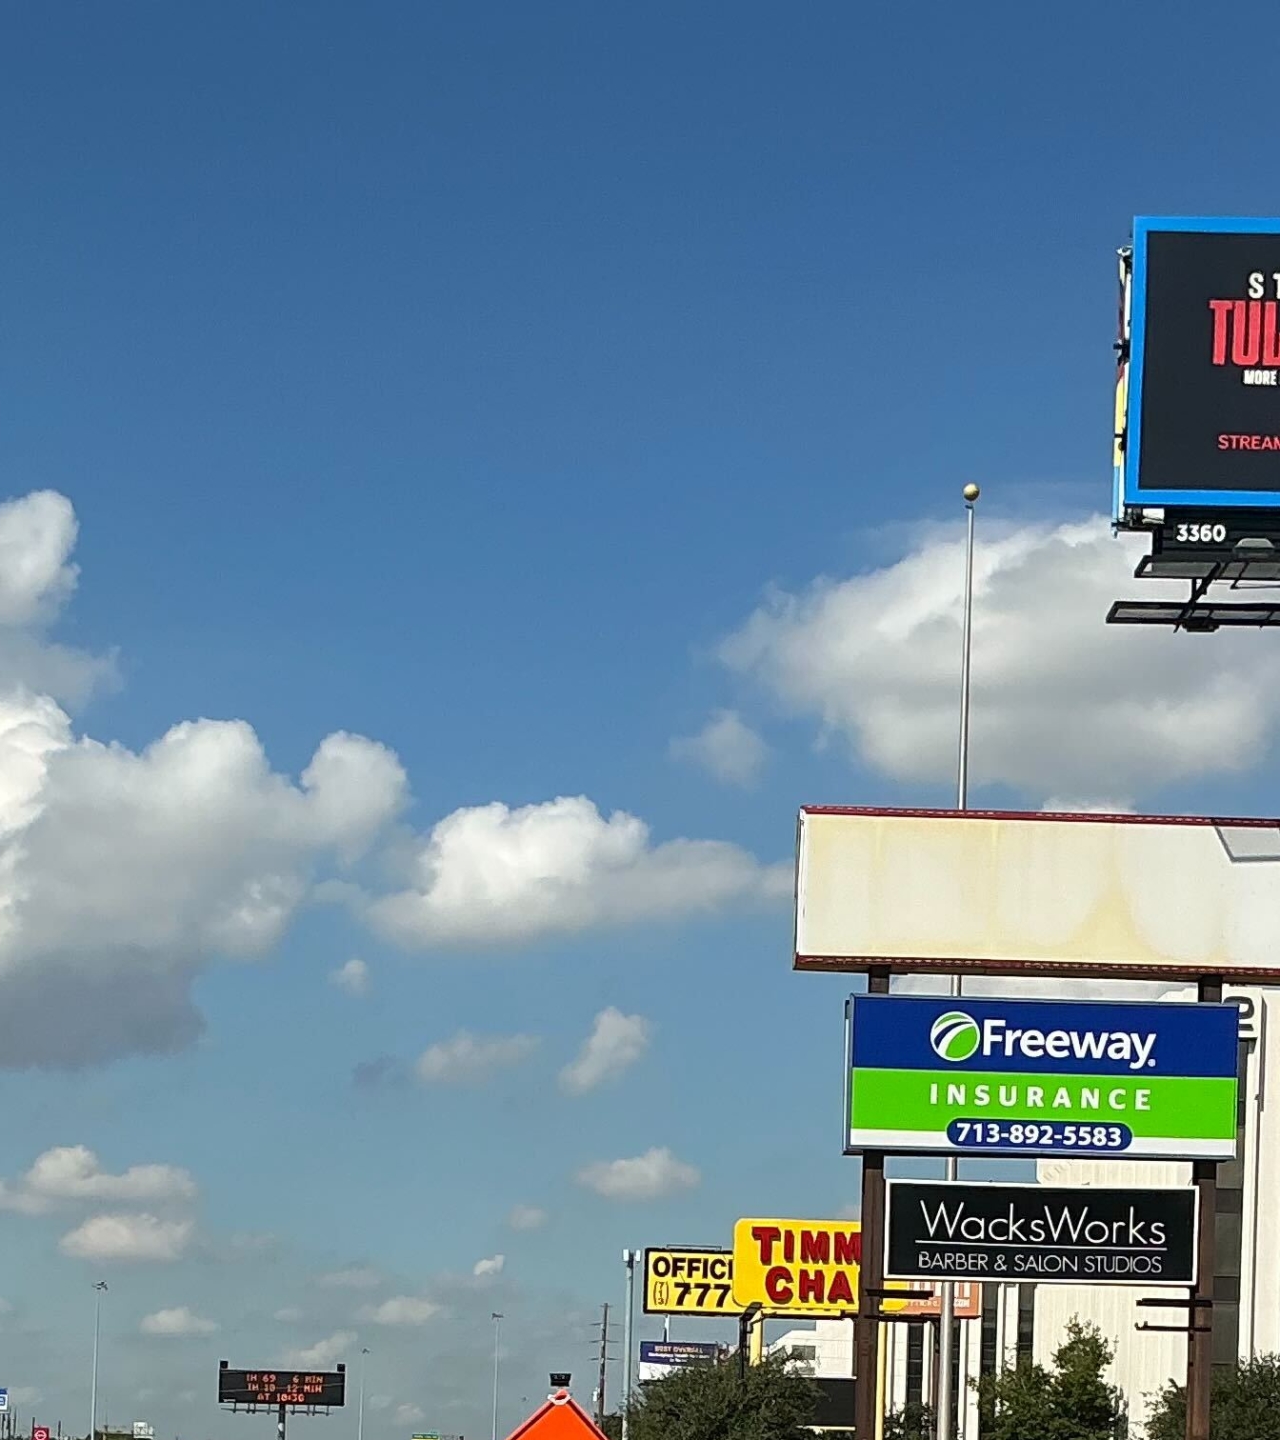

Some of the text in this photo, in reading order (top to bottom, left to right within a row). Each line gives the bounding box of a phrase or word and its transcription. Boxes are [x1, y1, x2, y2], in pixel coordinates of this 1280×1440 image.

[1243, 369, 1277, 386] MORE
[1176, 523, 1227, 543] 3360
[982, 1018, 1157, 1070] Freeway
[929, 1082, 1152, 1111] INSURANCE
[955, 1122, 1123, 1147] 713-892-5583
[920, 1199, 1167, 1245] WacksWorks
[918, 1251, 1162, 1274] BARBER & SALON STUDIOS
[673, 1282, 732, 1308] 777
